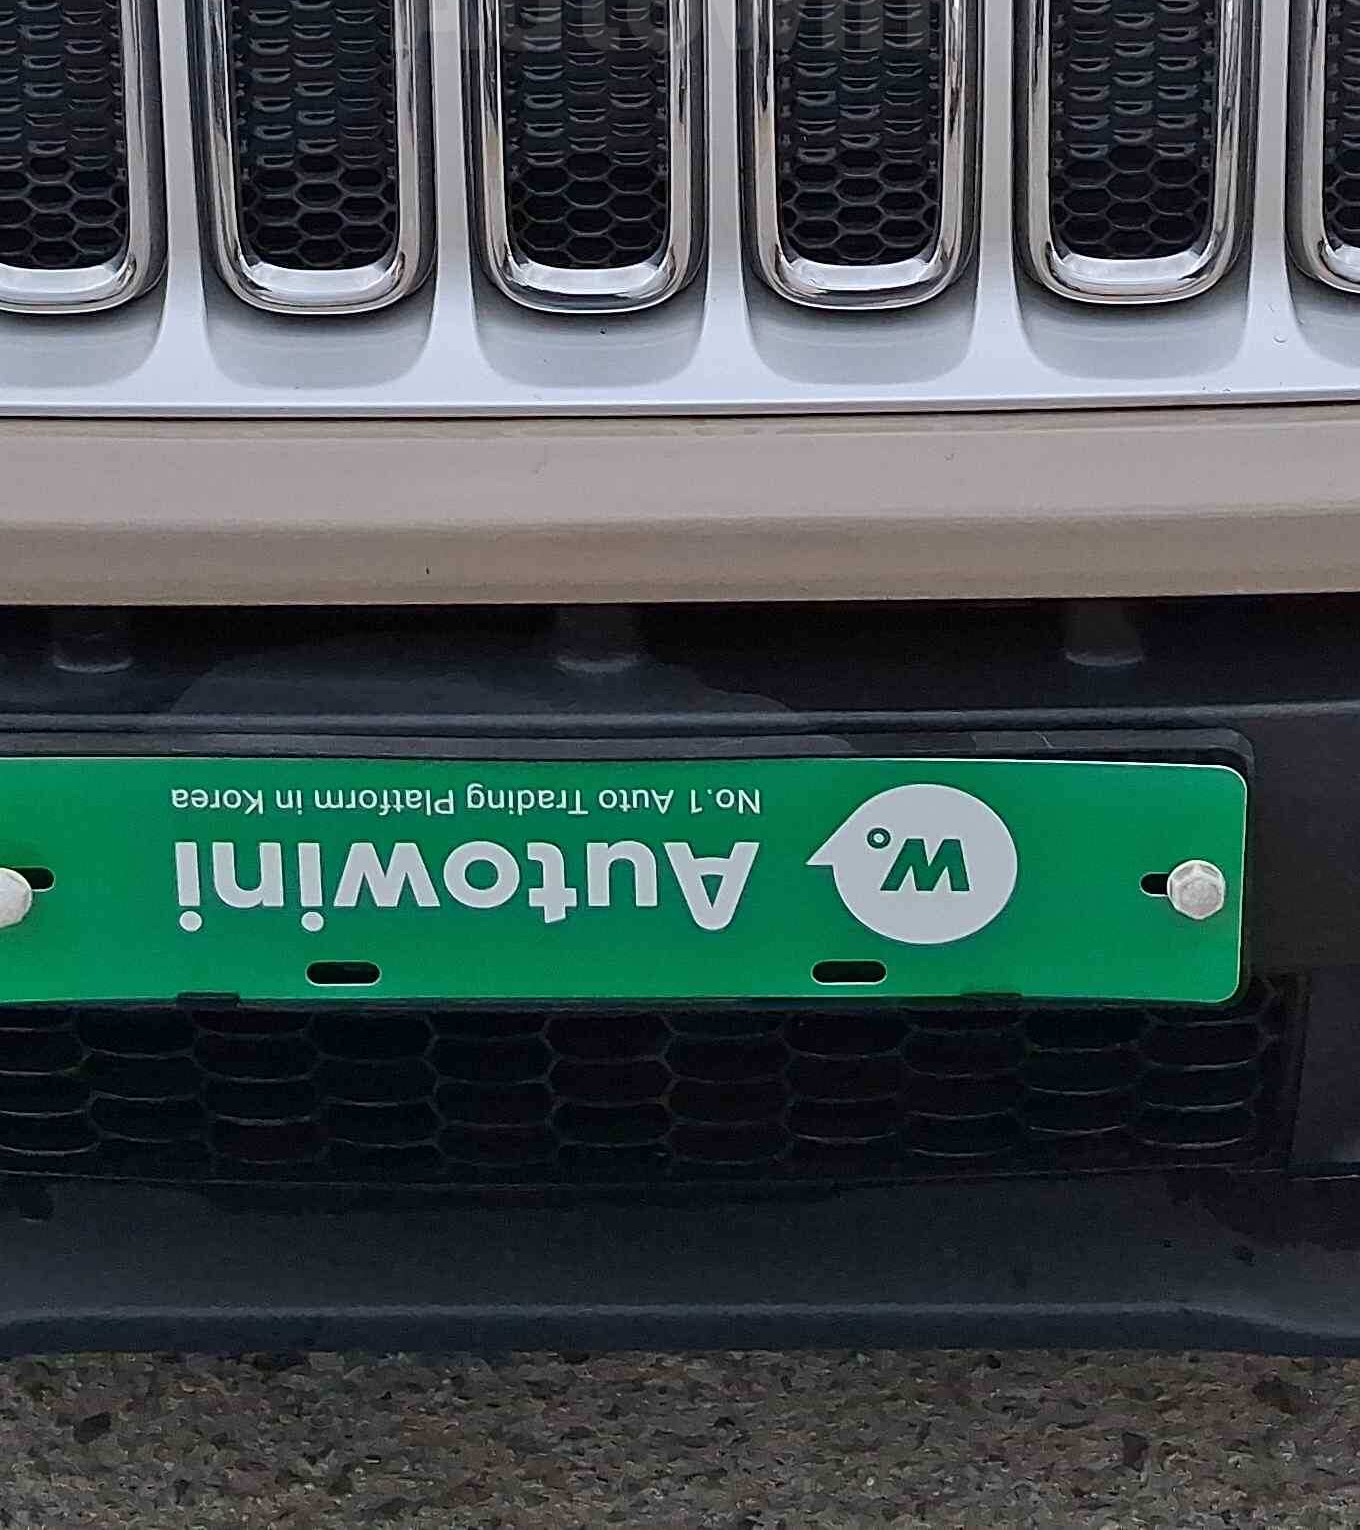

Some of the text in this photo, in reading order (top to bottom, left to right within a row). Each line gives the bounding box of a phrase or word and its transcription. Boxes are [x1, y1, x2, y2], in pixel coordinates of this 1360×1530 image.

[171, 783, 761, 815] No.1 Auto Trading Platform in Korea
[174, 840, 760, 932] Autowini
